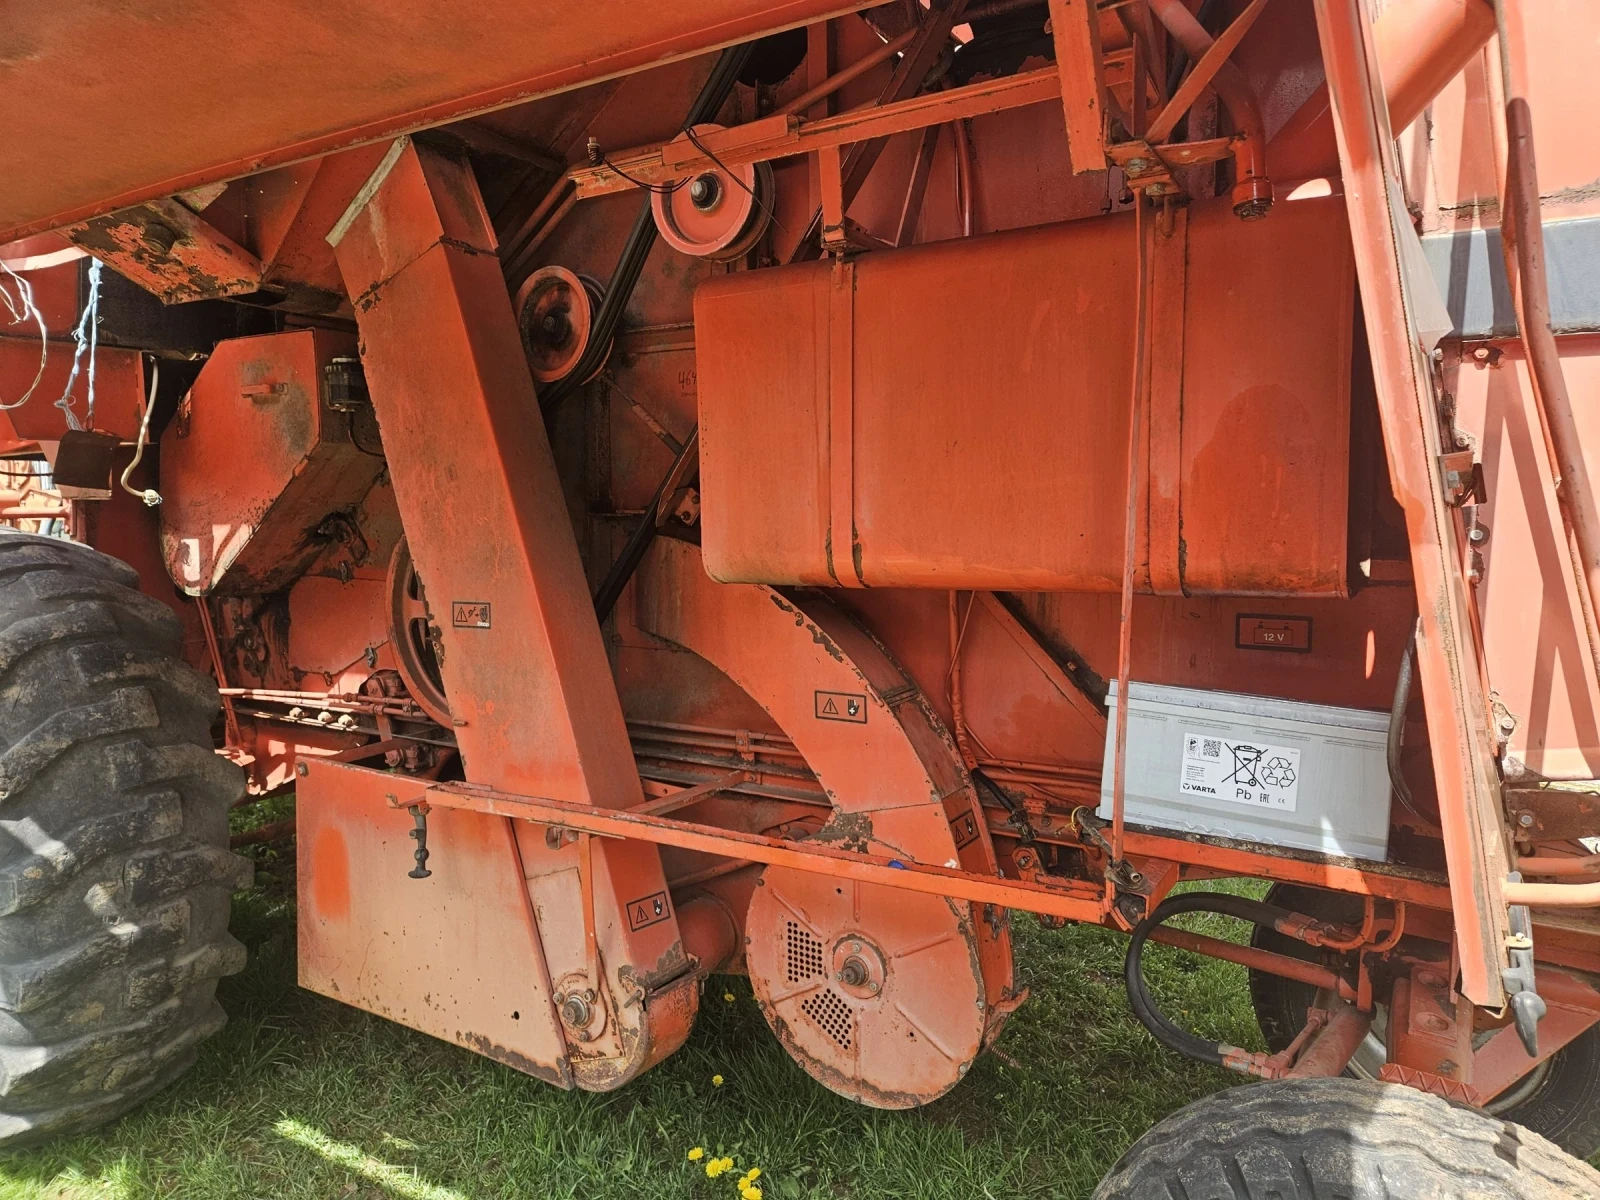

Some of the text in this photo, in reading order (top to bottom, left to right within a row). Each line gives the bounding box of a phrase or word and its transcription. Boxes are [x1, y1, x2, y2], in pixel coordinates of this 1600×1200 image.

[1263, 633, 1284, 641] 12 V
[1192, 784, 1216, 794] VARTA
[1236, 788, 1252, 800] Pb
